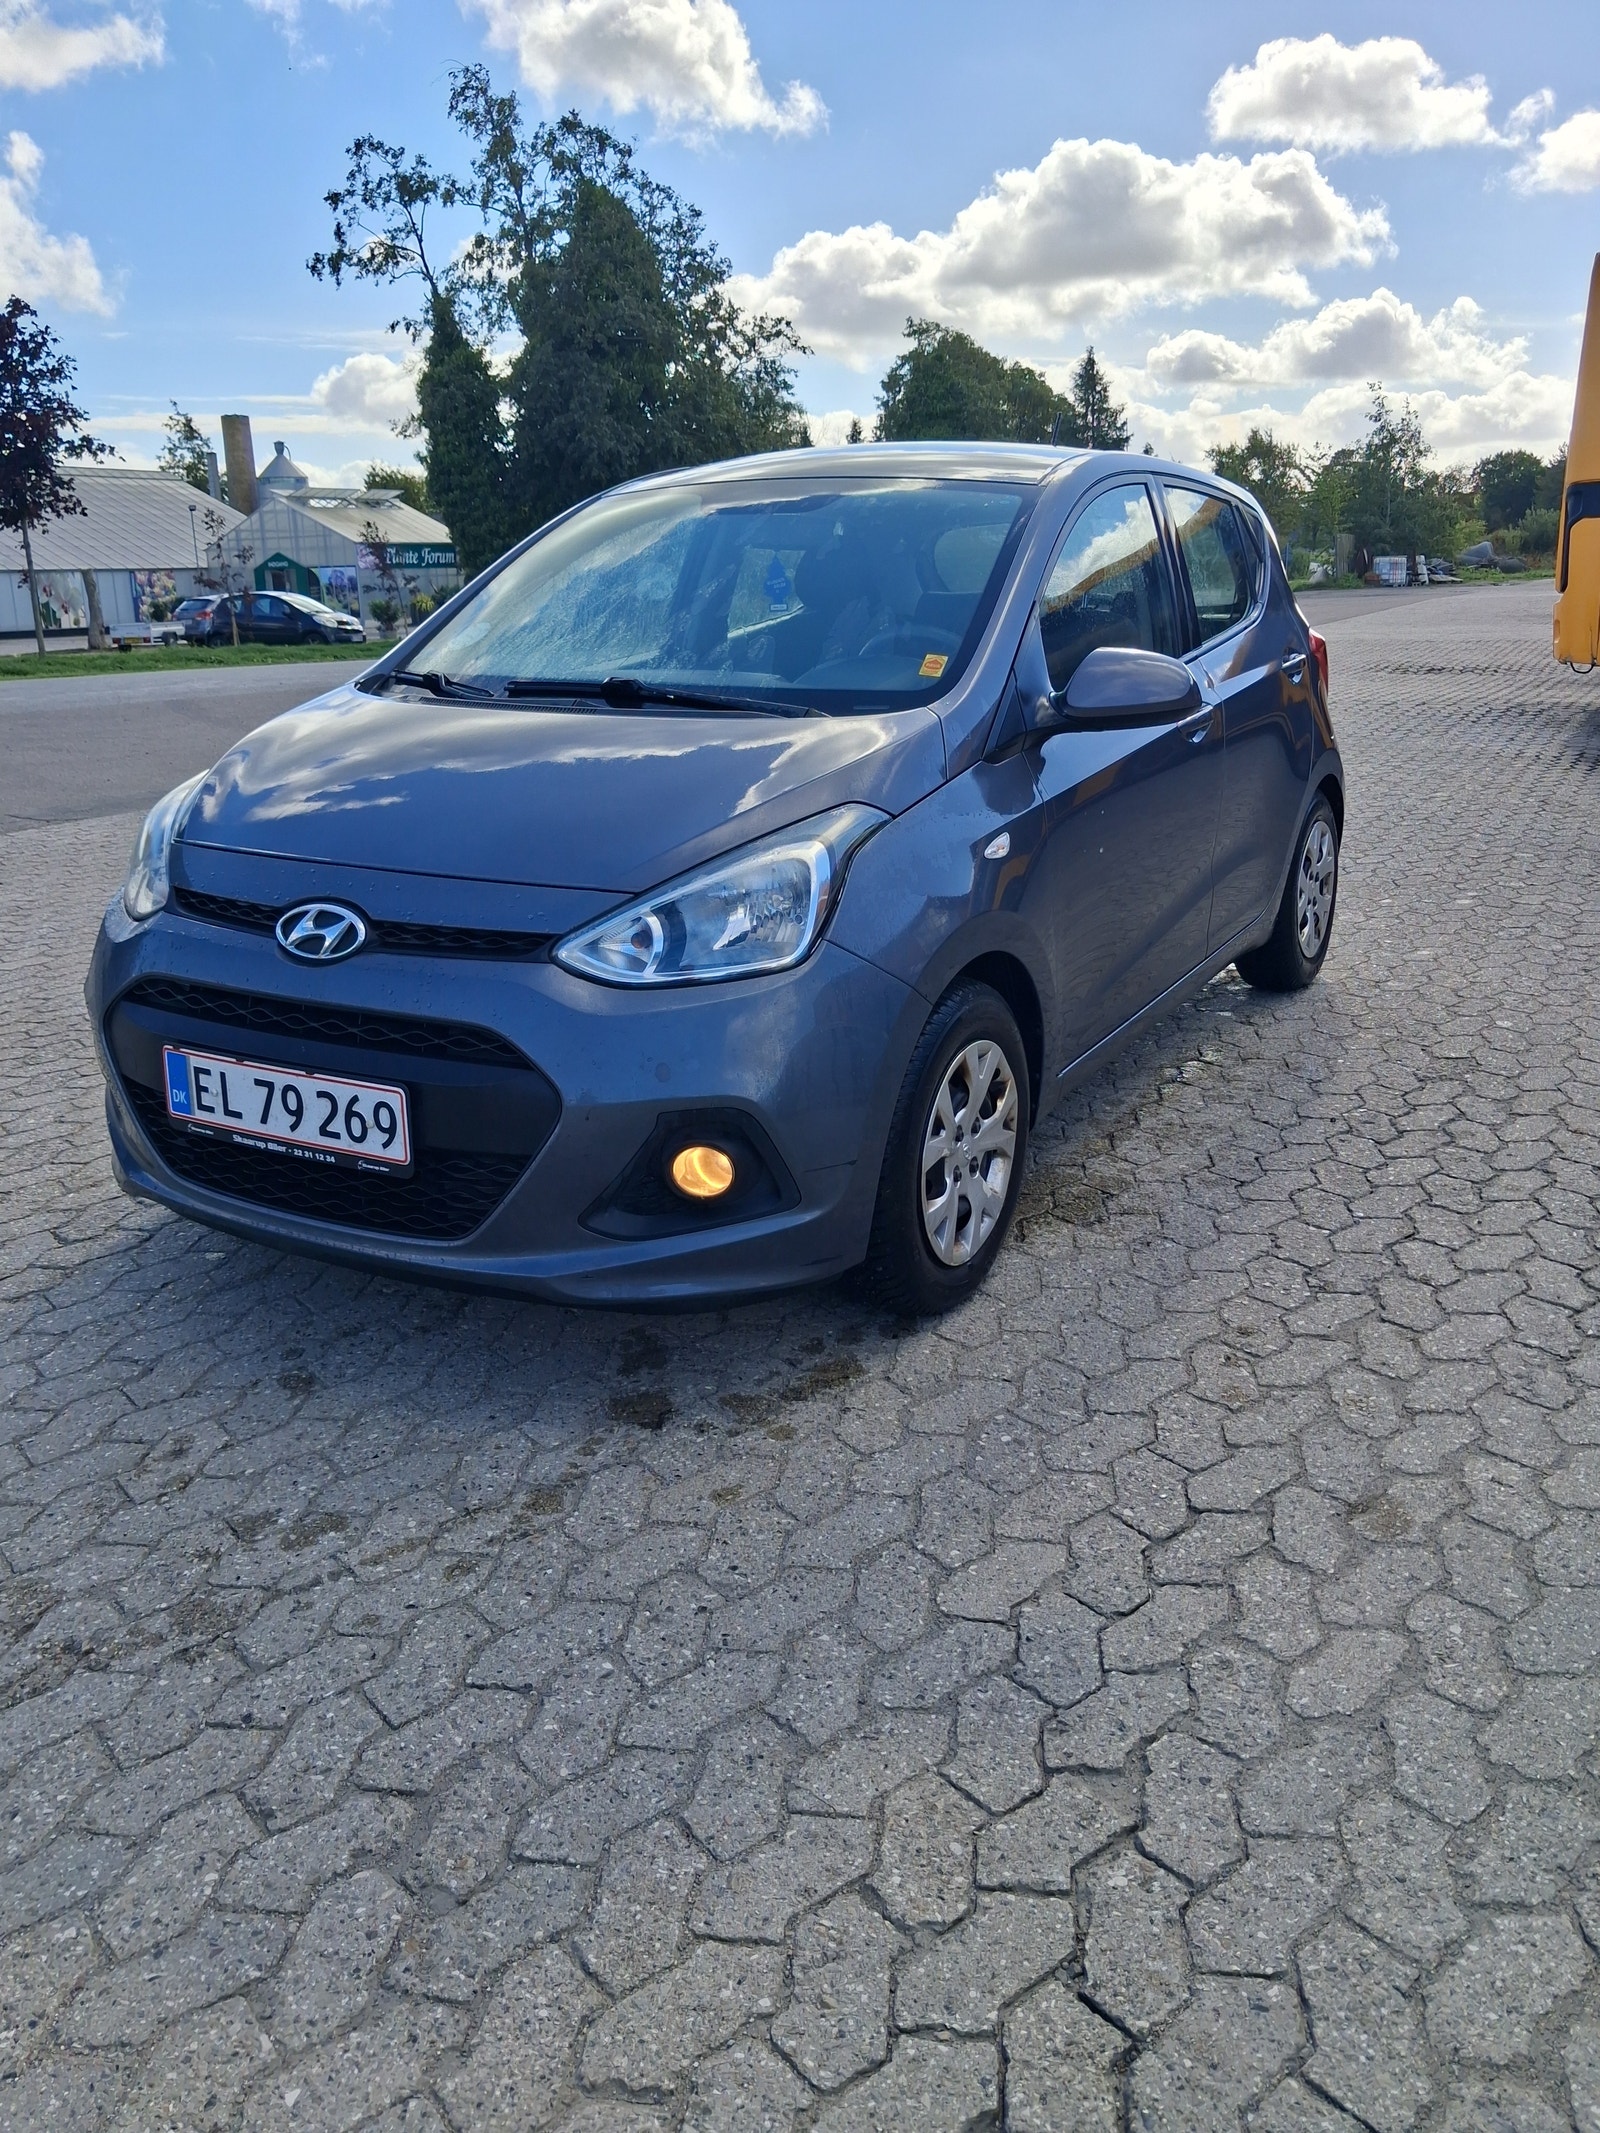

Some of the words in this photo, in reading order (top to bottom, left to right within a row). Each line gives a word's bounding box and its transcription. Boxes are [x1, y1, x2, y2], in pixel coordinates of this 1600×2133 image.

[421, 548, 455, 567] Forum
[172, 1089, 187, 1105] DK
[193, 1066, 243, 1120] EL
[253, 1078, 304, 1133] 79
[316, 1090, 398, 1150] 269
[293, 1148, 303, 1157] 22
[315, 1153, 325, 1161] 12
